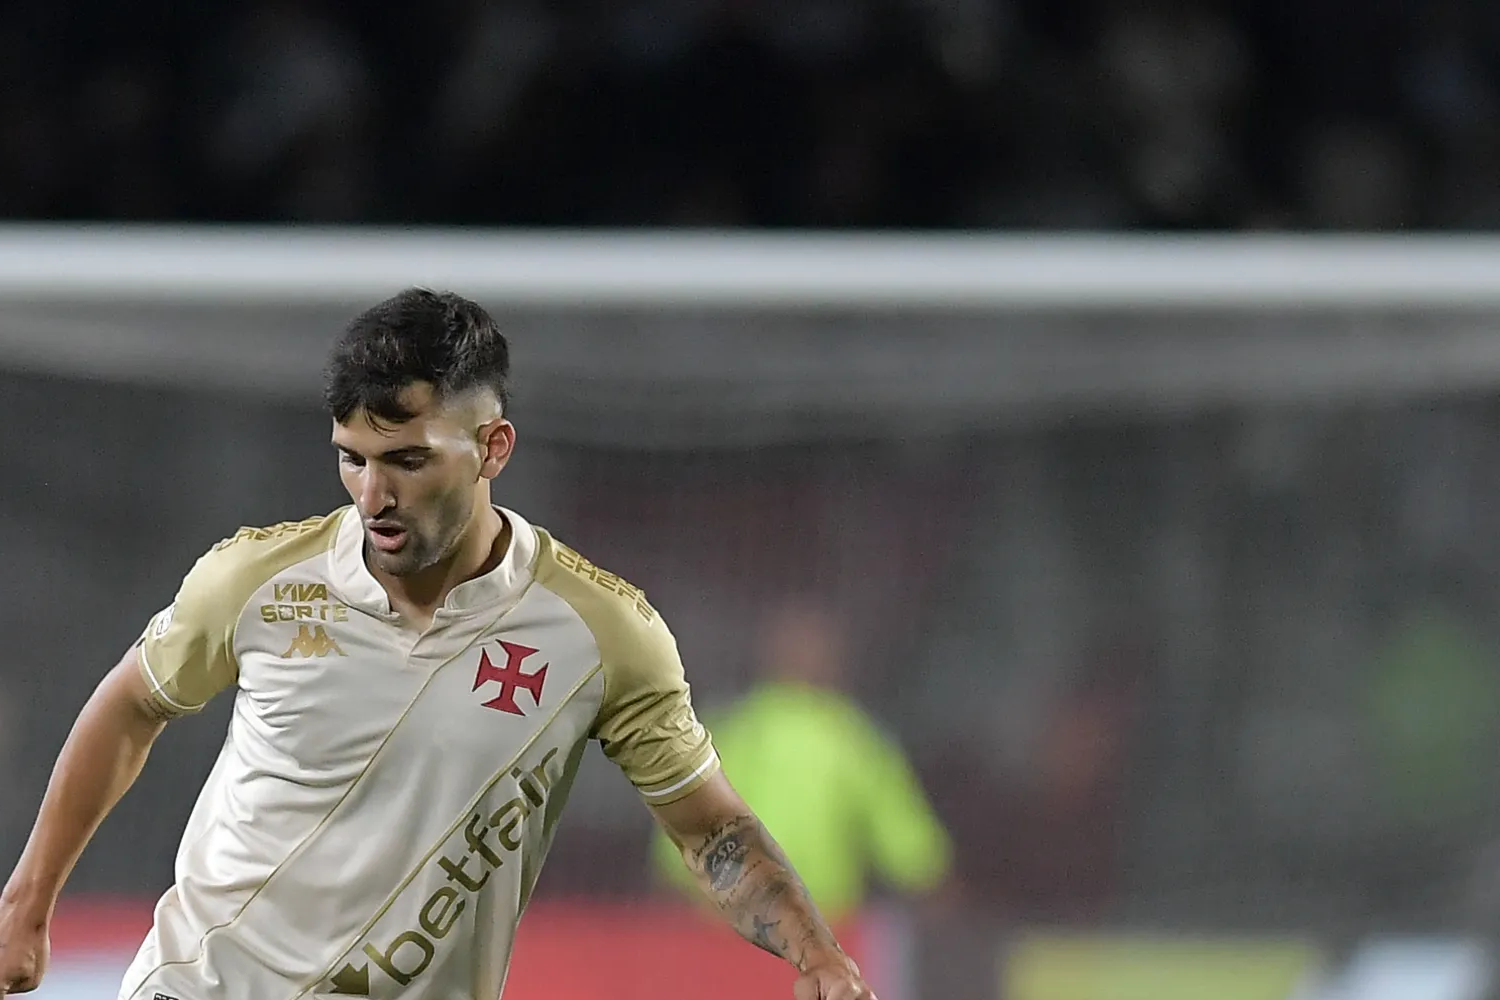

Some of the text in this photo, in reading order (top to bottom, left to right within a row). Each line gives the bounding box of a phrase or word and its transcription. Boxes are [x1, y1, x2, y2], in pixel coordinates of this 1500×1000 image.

[274, 583, 328, 602] VIVA
[260, 603, 349, 623] SORTE
[362, 746, 558, 986] betfair
